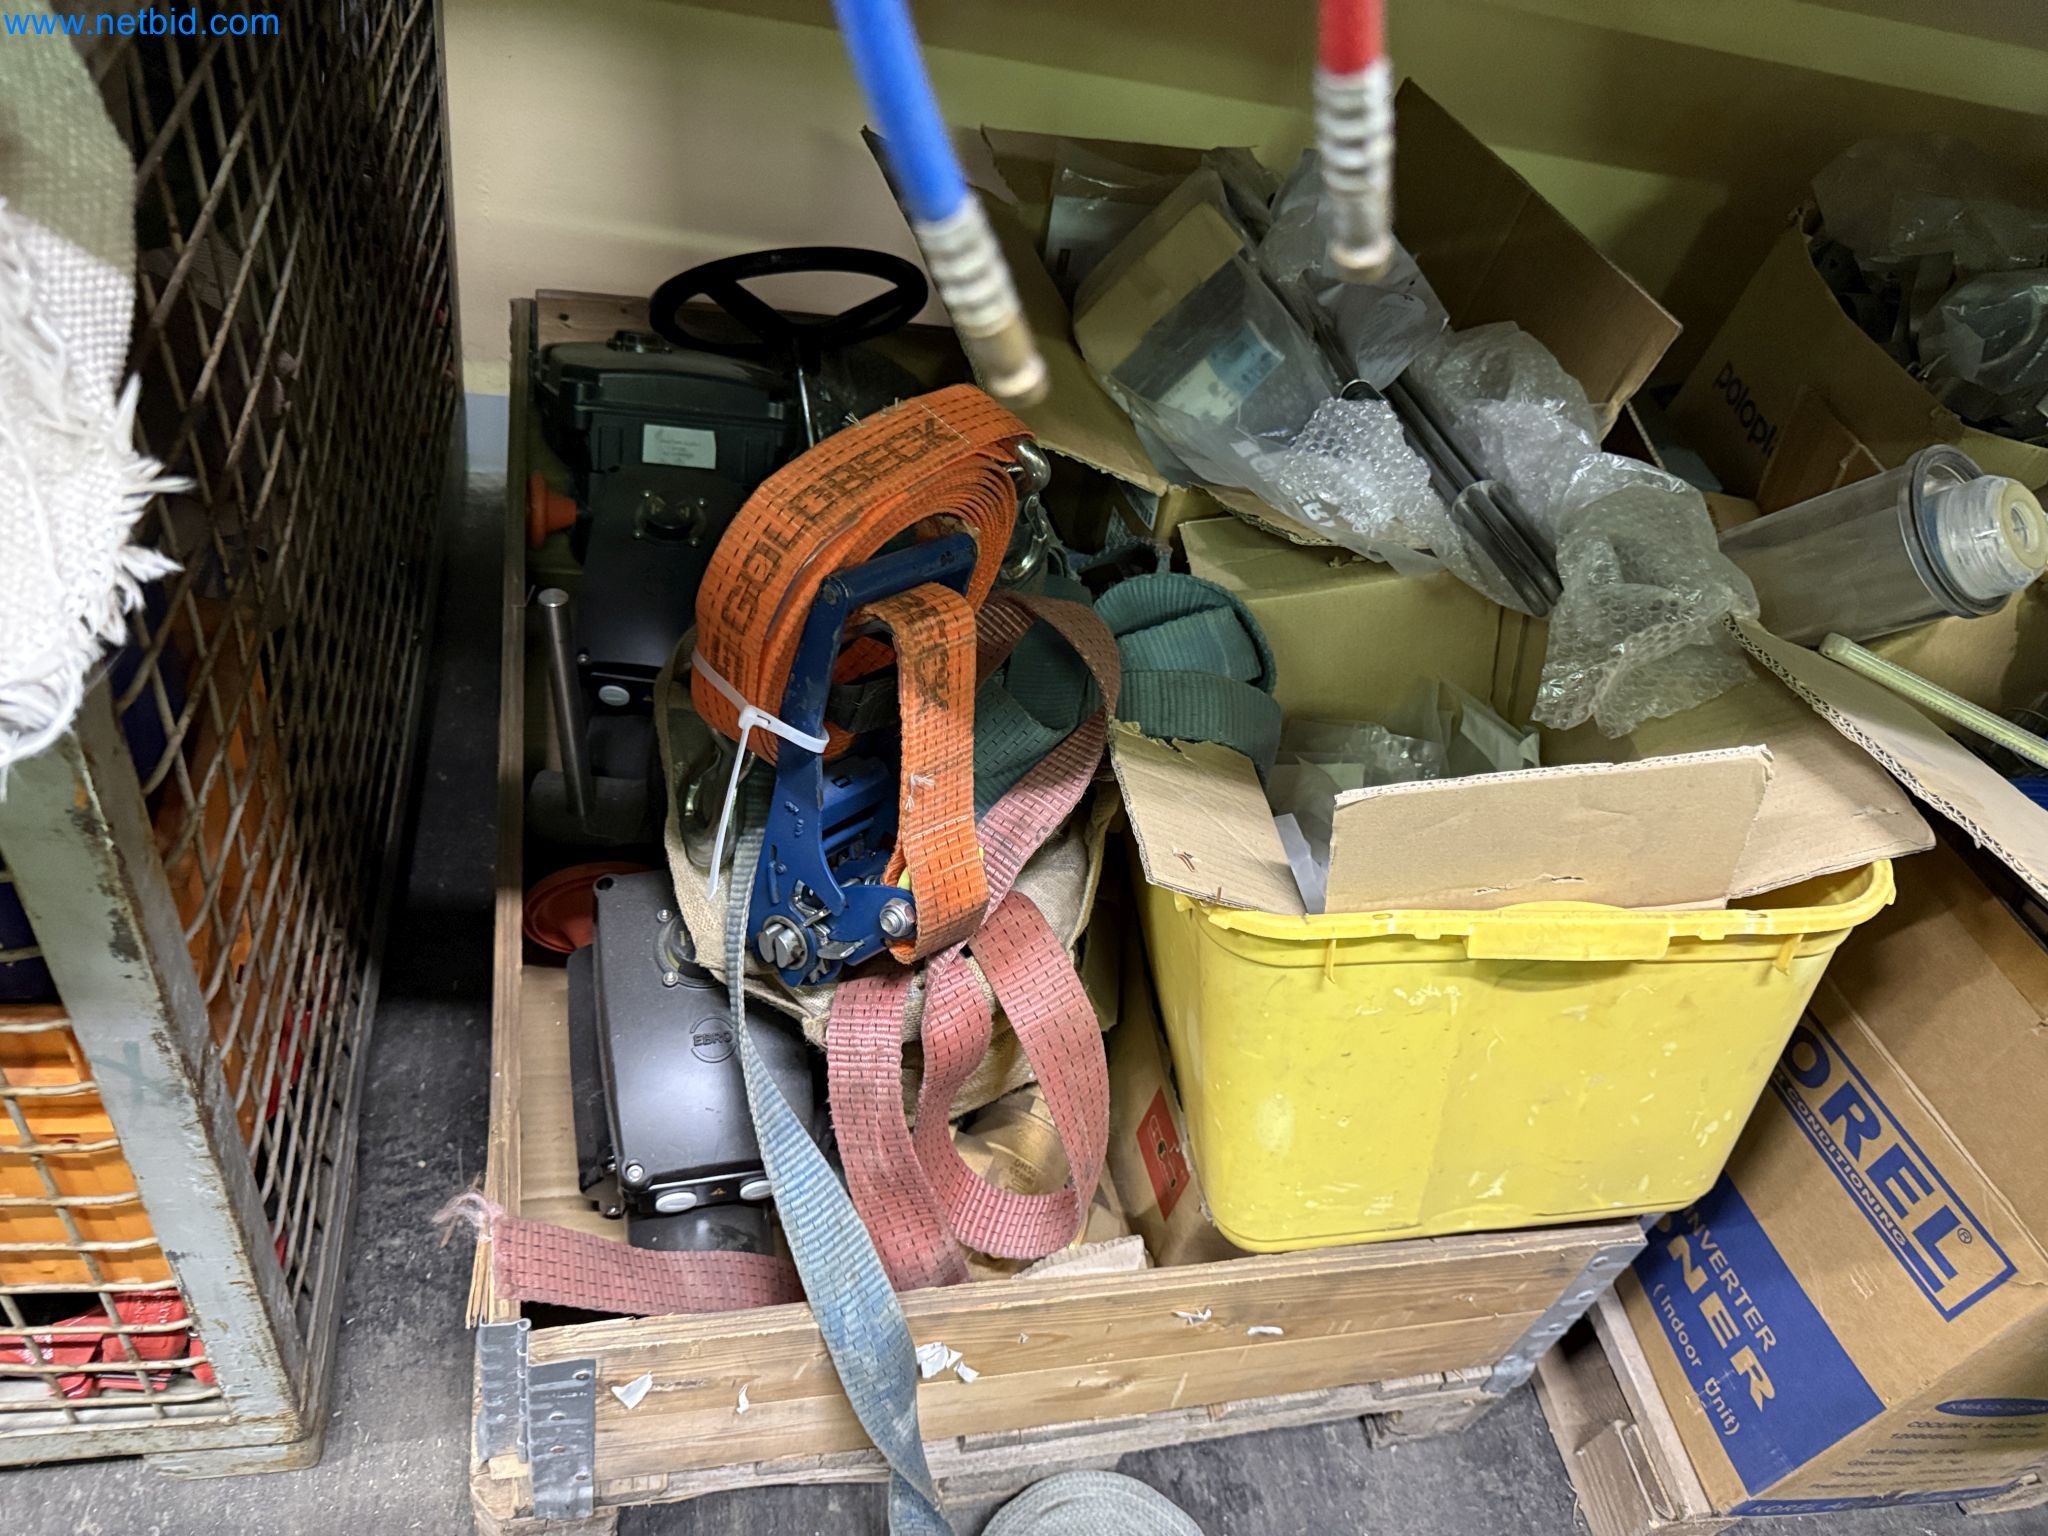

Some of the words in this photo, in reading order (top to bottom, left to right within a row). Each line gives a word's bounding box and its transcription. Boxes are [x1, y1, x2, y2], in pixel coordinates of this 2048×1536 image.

[1711, 358, 1778, 459] polopl
[693, 1031, 734, 1047] EBRO
[1785, 1086, 1908, 1247] CONDITIONING
[1657, 1213, 1776, 1412] NER
[1703, 1376, 1741, 1437] Unit)
